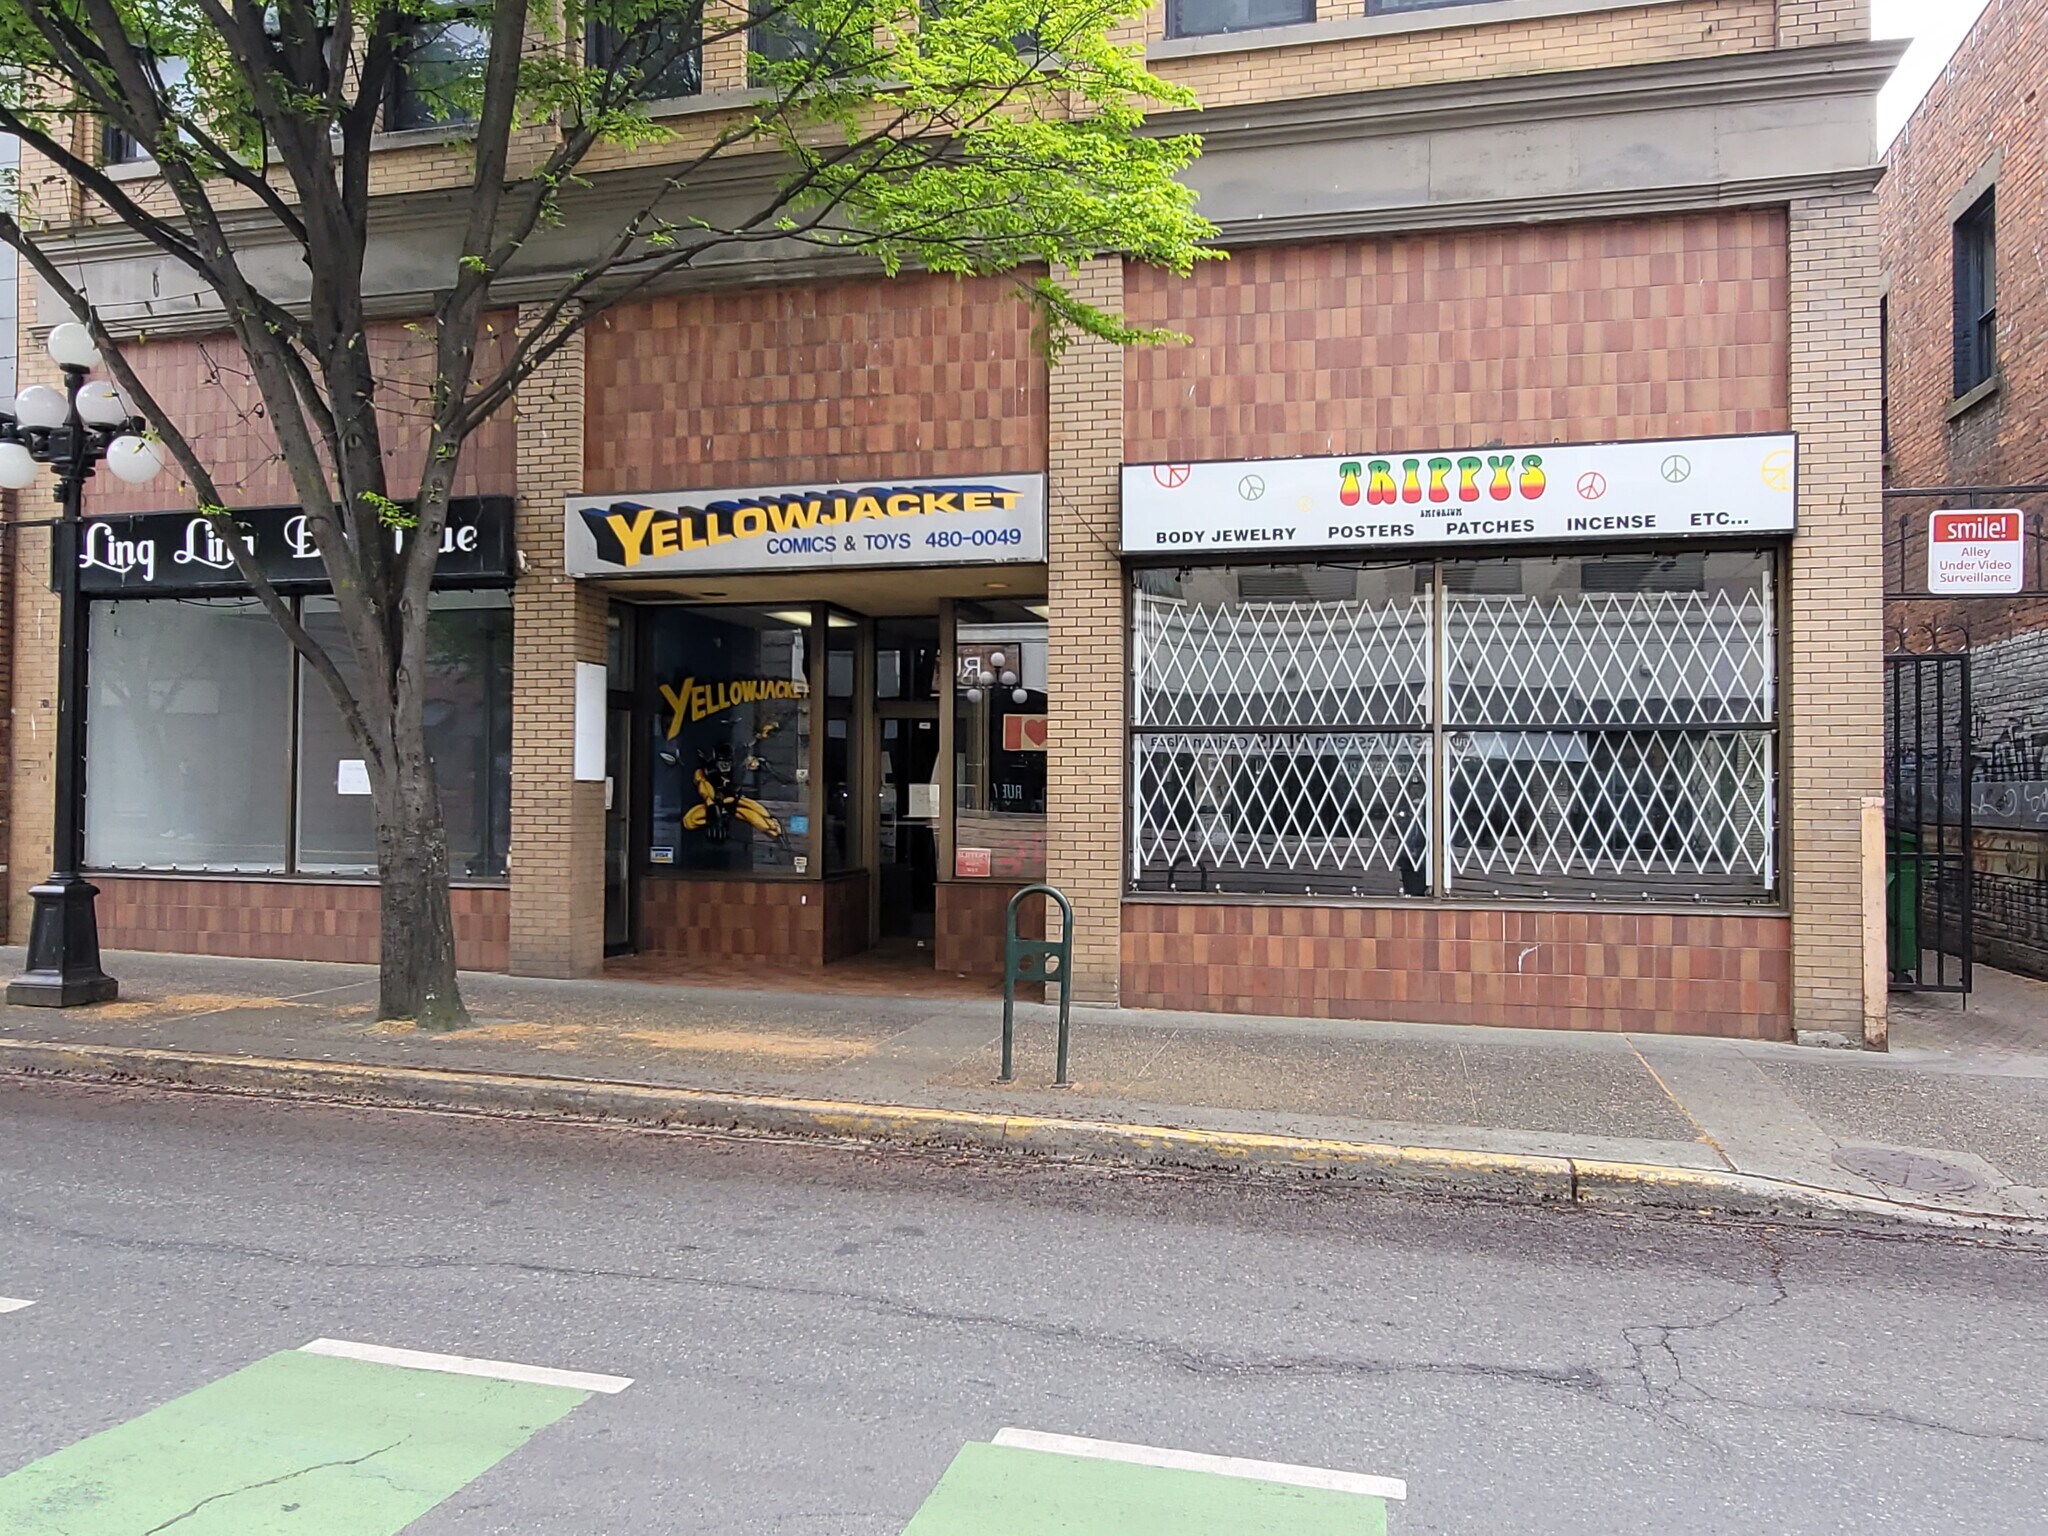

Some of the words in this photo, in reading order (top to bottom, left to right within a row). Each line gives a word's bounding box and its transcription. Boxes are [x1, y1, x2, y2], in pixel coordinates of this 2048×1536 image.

[1339, 454, 1546, 506] TRIPPYS
[606, 491, 1024, 566] YELLOWJACKET
[766, 535, 837, 554] COMICS
[844, 535, 857, 552] &
[864, 533, 911, 551] TOYS
[925, 528, 1022, 548] 480-0049
[1156, 530, 1205, 544] BODY
[1211, 528, 1297, 543] JEWELRY
[1328, 524, 1415, 538] POSTERS
[1446, 519, 1535, 535] PATCHES
[1567, 515, 1656, 531] INCENSE
[1690, 512, 1749, 526] ETC...
[1947, 516, 2006, 539] smile!
[79, 522, 155, 581] Ling
[174, 517, 254, 569] Lin
[1961, 547, 1991, 558] Alley
[1939, 561, 1975, 570] Under
[1978, 560, 2012, 570] Video
[1939, 573, 2012, 583] Surveillance
[659, 677, 809, 741] YELLOWJACKET
